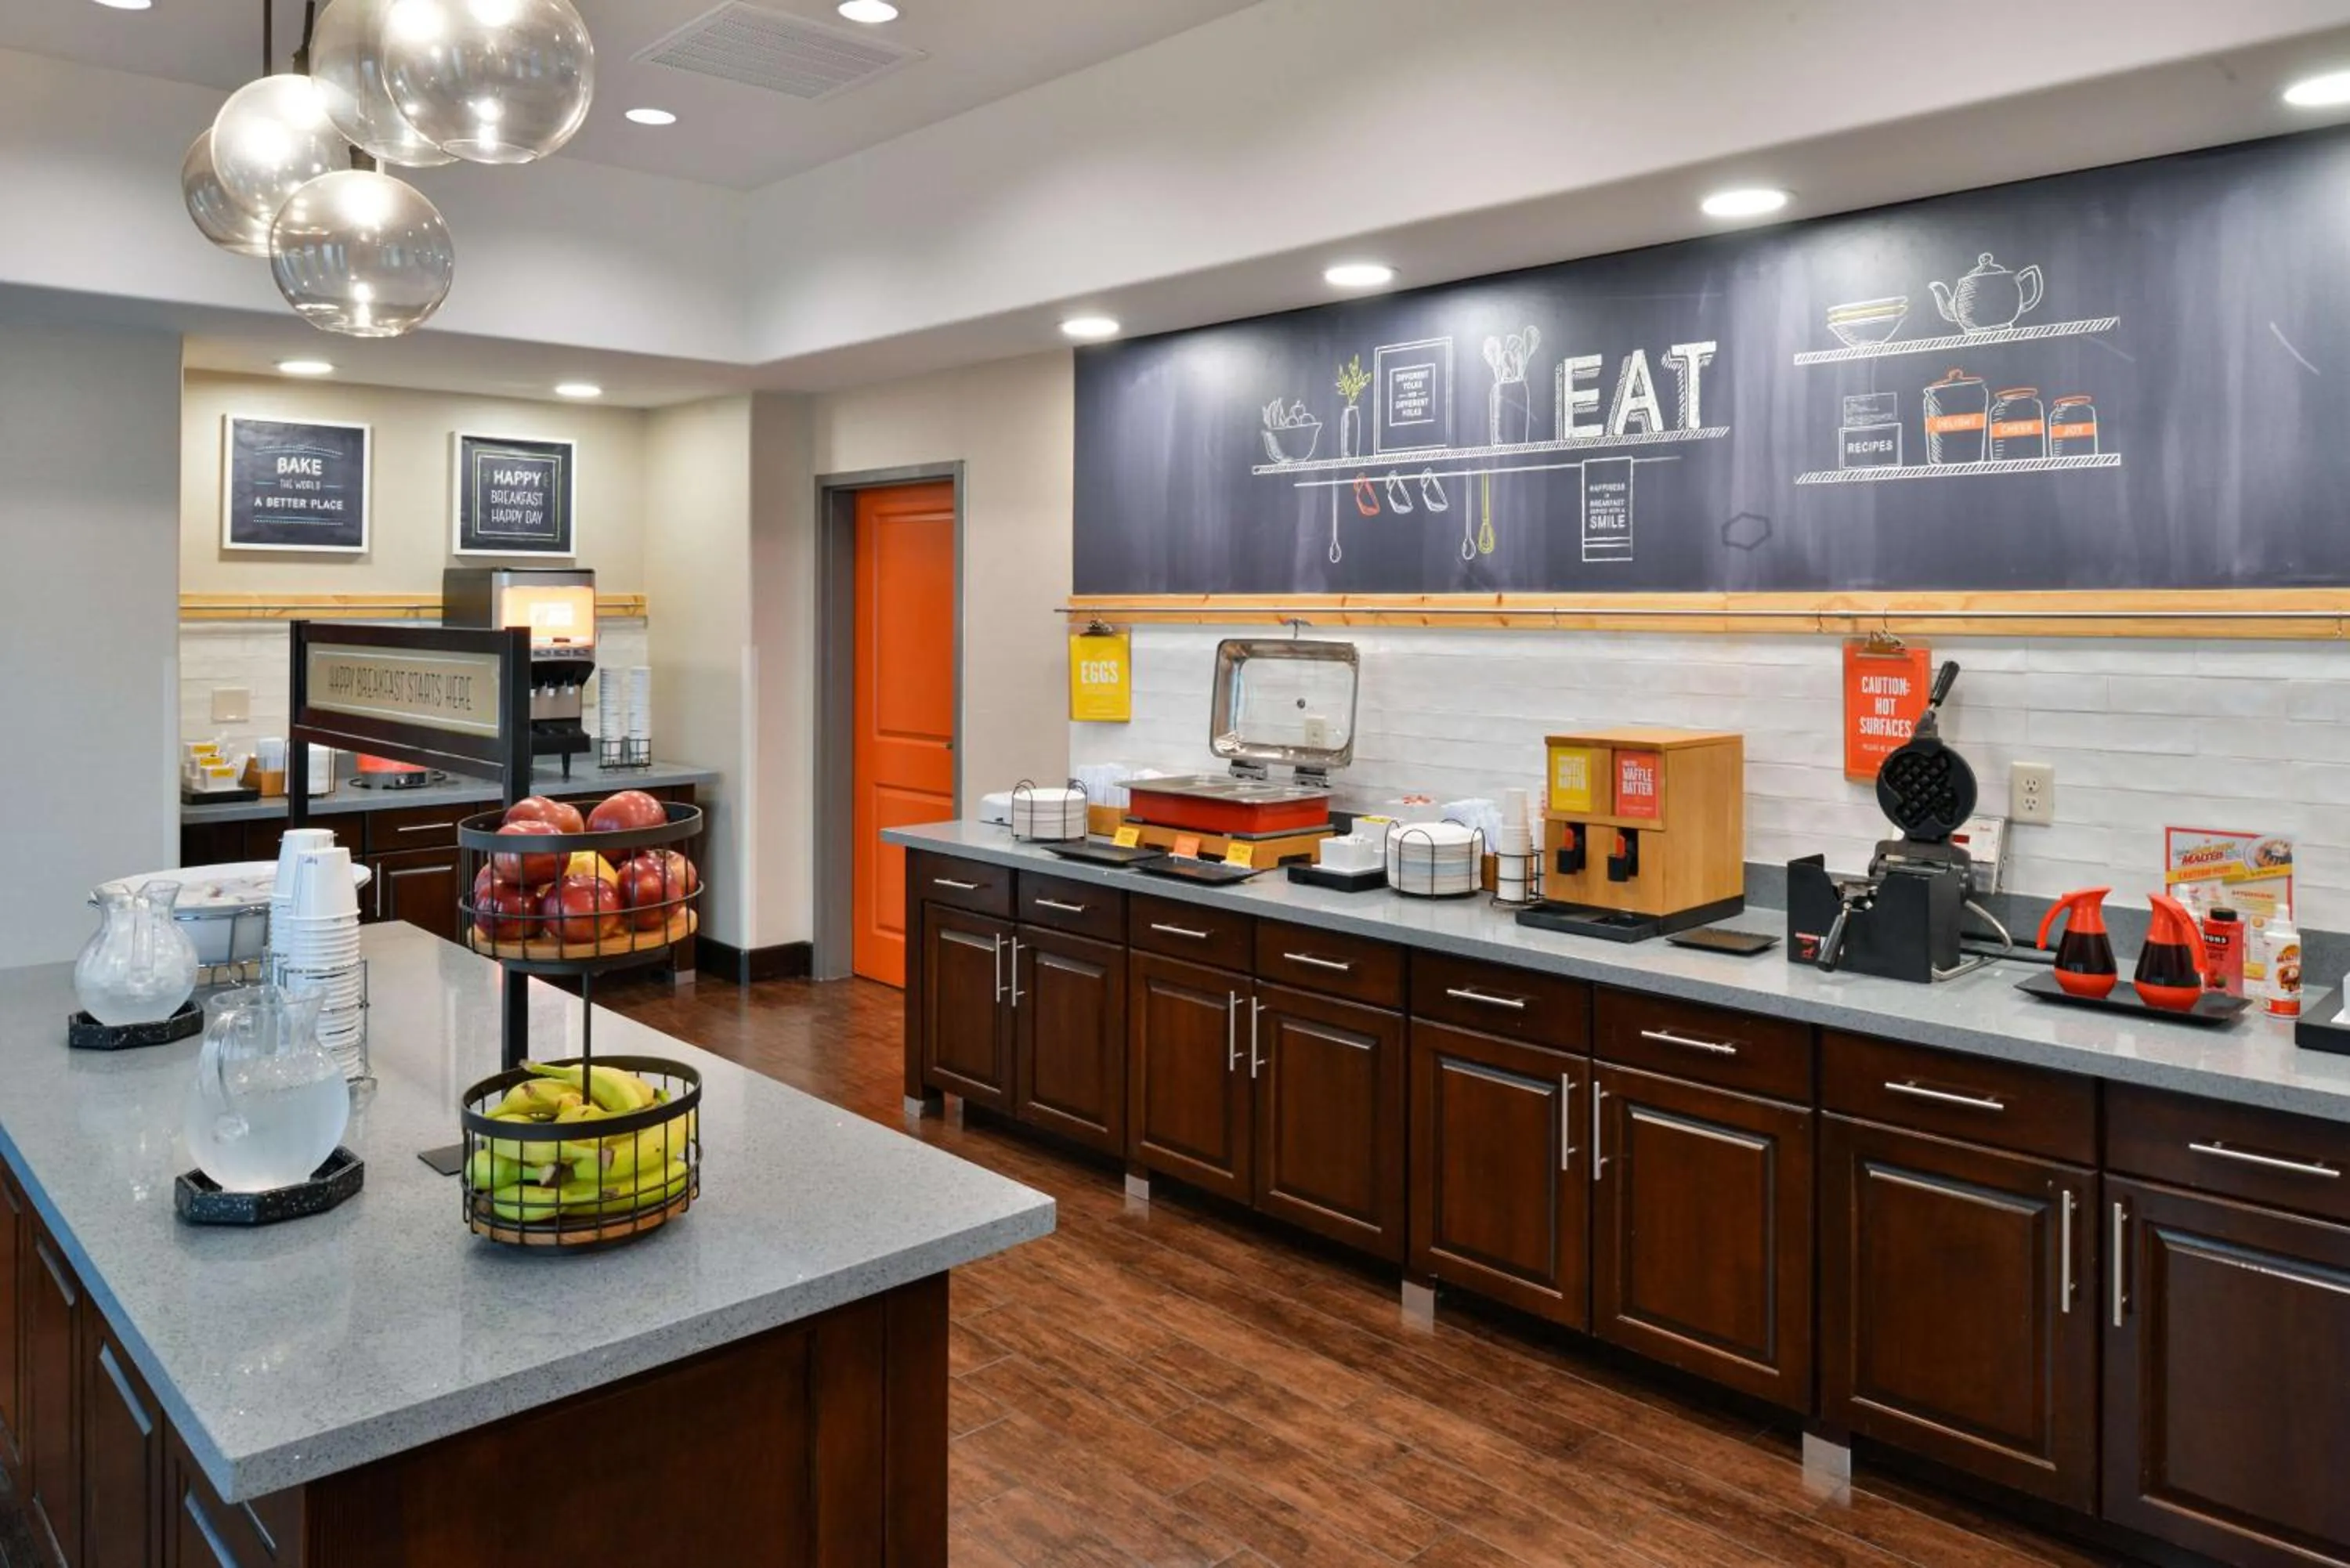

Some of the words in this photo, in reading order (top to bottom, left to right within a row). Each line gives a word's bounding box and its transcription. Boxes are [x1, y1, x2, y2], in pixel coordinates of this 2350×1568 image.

[1556, 341, 1716, 439] EAT
[1937, 417, 1976, 428] DELIGHT
[2001, 424, 2034, 434] CHEER
[2063, 426, 2084, 436] JOY
[1847, 440, 1893, 453] RECIPES
[277, 457, 323, 476] BAKE
[493, 470, 542, 486] HAPPY
[254, 496, 262, 507] A
[266, 497, 307, 509] BETTER
[311, 498, 344, 511] PLACE
[490, 490, 544, 506] BREAKFAST
[491, 508, 523, 524] HAPPY
[526, 510, 544, 525] DAY
[1589, 514, 1625, 529] SMILE
[1080, 660, 1119, 684] EGGS
[328, 664, 354, 697] HAPPY
[356, 666, 403, 702] BREAKFAST
[408, 671, 441, 706] STARTS
[446, 676, 472, 711] HERE
[1861, 676, 1911, 695] CAUTION:
[1875, 698, 1896, 715] HOT
[1860, 717, 1912, 737] SURFACES
[1622, 767, 1654, 782] WAFFLE
[1622, 780, 1654, 797] BATTER
